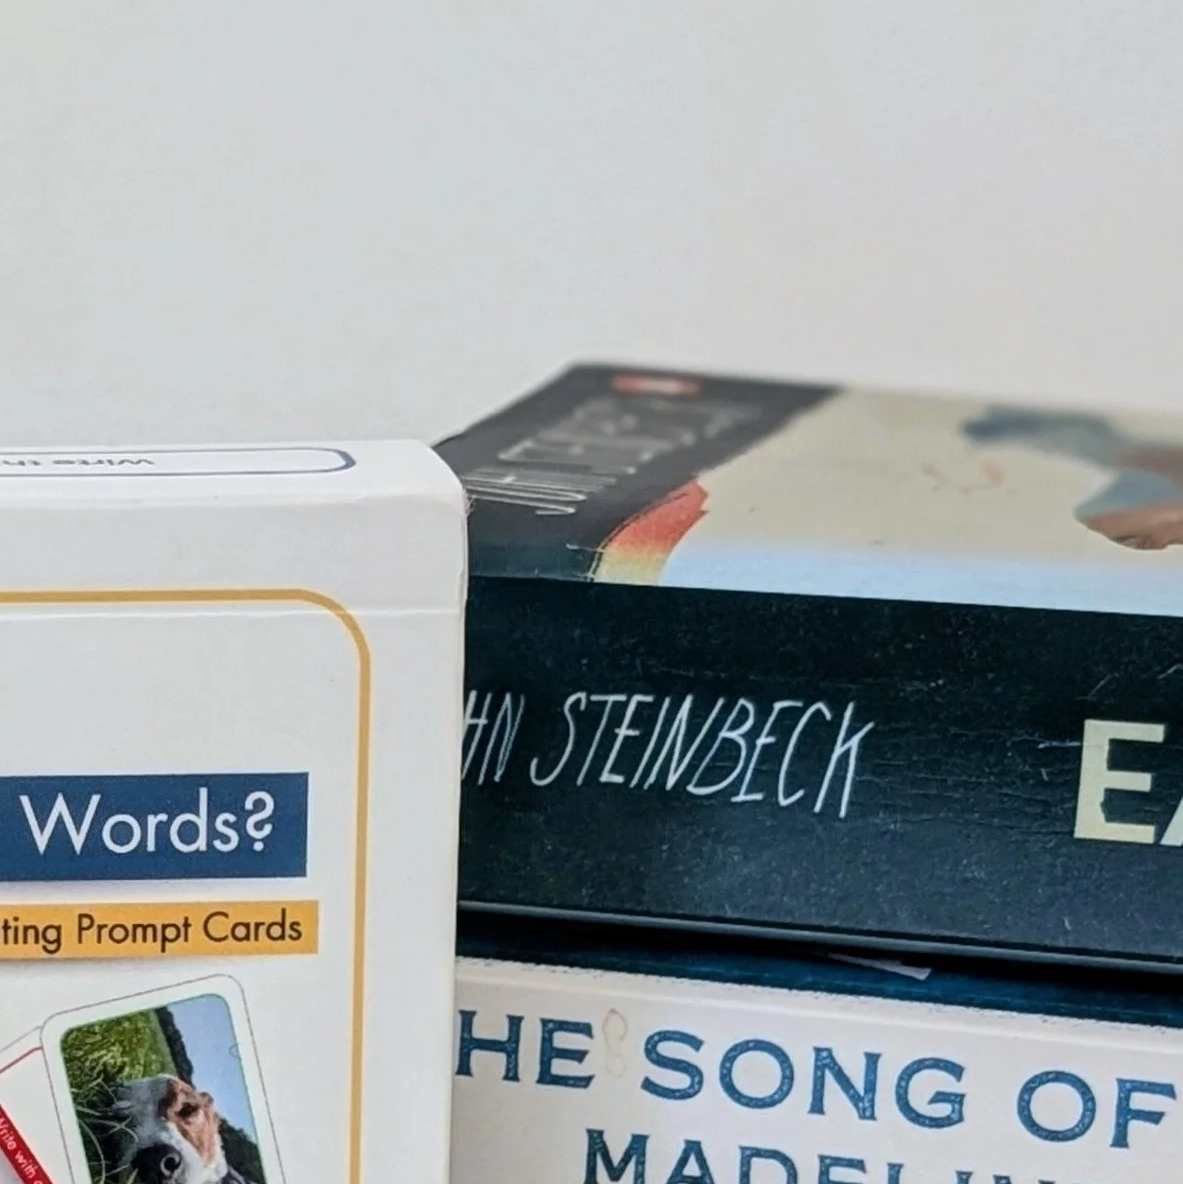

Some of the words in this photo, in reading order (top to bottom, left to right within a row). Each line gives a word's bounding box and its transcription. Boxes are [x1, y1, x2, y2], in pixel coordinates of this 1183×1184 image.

[530, 690, 875, 819] STEINBECK
[18, 787, 275, 856] Words?
[77, 911, 192, 953] Prompt
[202, 908, 303, 943] Cards
[640, 1030, 967, 1130] SONG
[1017, 1070, 1177, 1149] OF
[15, 1149, 38, 1179] with
